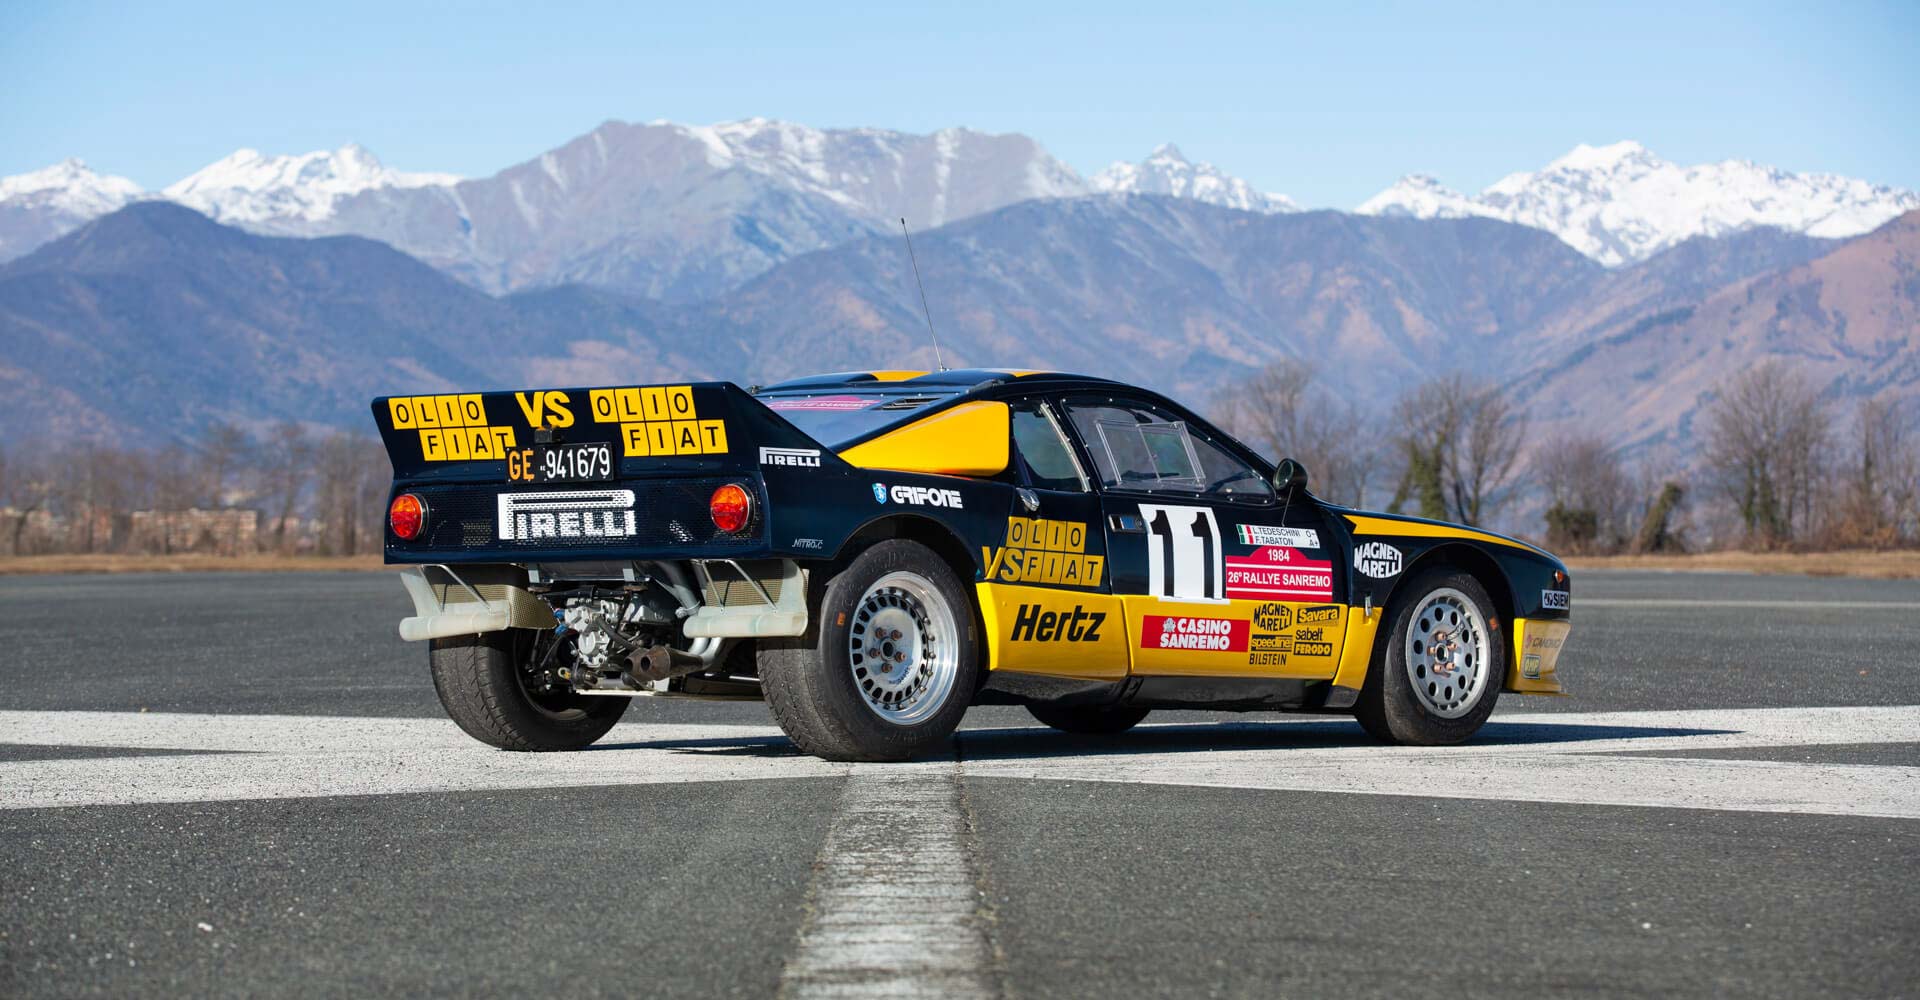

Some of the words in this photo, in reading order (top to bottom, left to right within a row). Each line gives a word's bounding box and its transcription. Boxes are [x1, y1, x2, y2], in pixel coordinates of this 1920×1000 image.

[395, 400, 480, 423] OLIO
[514, 391, 575, 428] VS
[597, 392, 689, 416] OLIO
[427, 432, 508, 454] FIAT
[629, 426, 718, 449] FIAT
[508, 450, 535, 480] GE
[545, 447, 611, 479] 941679
[759, 446, 822, 467] PIRELLI
[890, 485, 964, 509] GRIFONE
[497, 489, 637, 540] PIRELLI
[1011, 522, 1082, 548] OLIO
[982, 546, 1024, 582] VS
[1027, 556, 1099, 581] FIAT
[1150, 509, 1215, 600] 11
[1267, 549, 1290, 562] 1984
[1243, 572, 1281, 586] RALLYE
[1282, 574, 1331, 588] SANREMO
[1010, 604, 1107, 642] Hertz
[1177, 618, 1232, 635] CASINO
[1299, 608, 1339, 623] Savara
[1160, 633, 1231, 650] SANREMO
[1295, 628, 1324, 641] sabelt
[1249, 653, 1288, 666] BILSTEIN
[1295, 643, 1331, 656] FERODO
